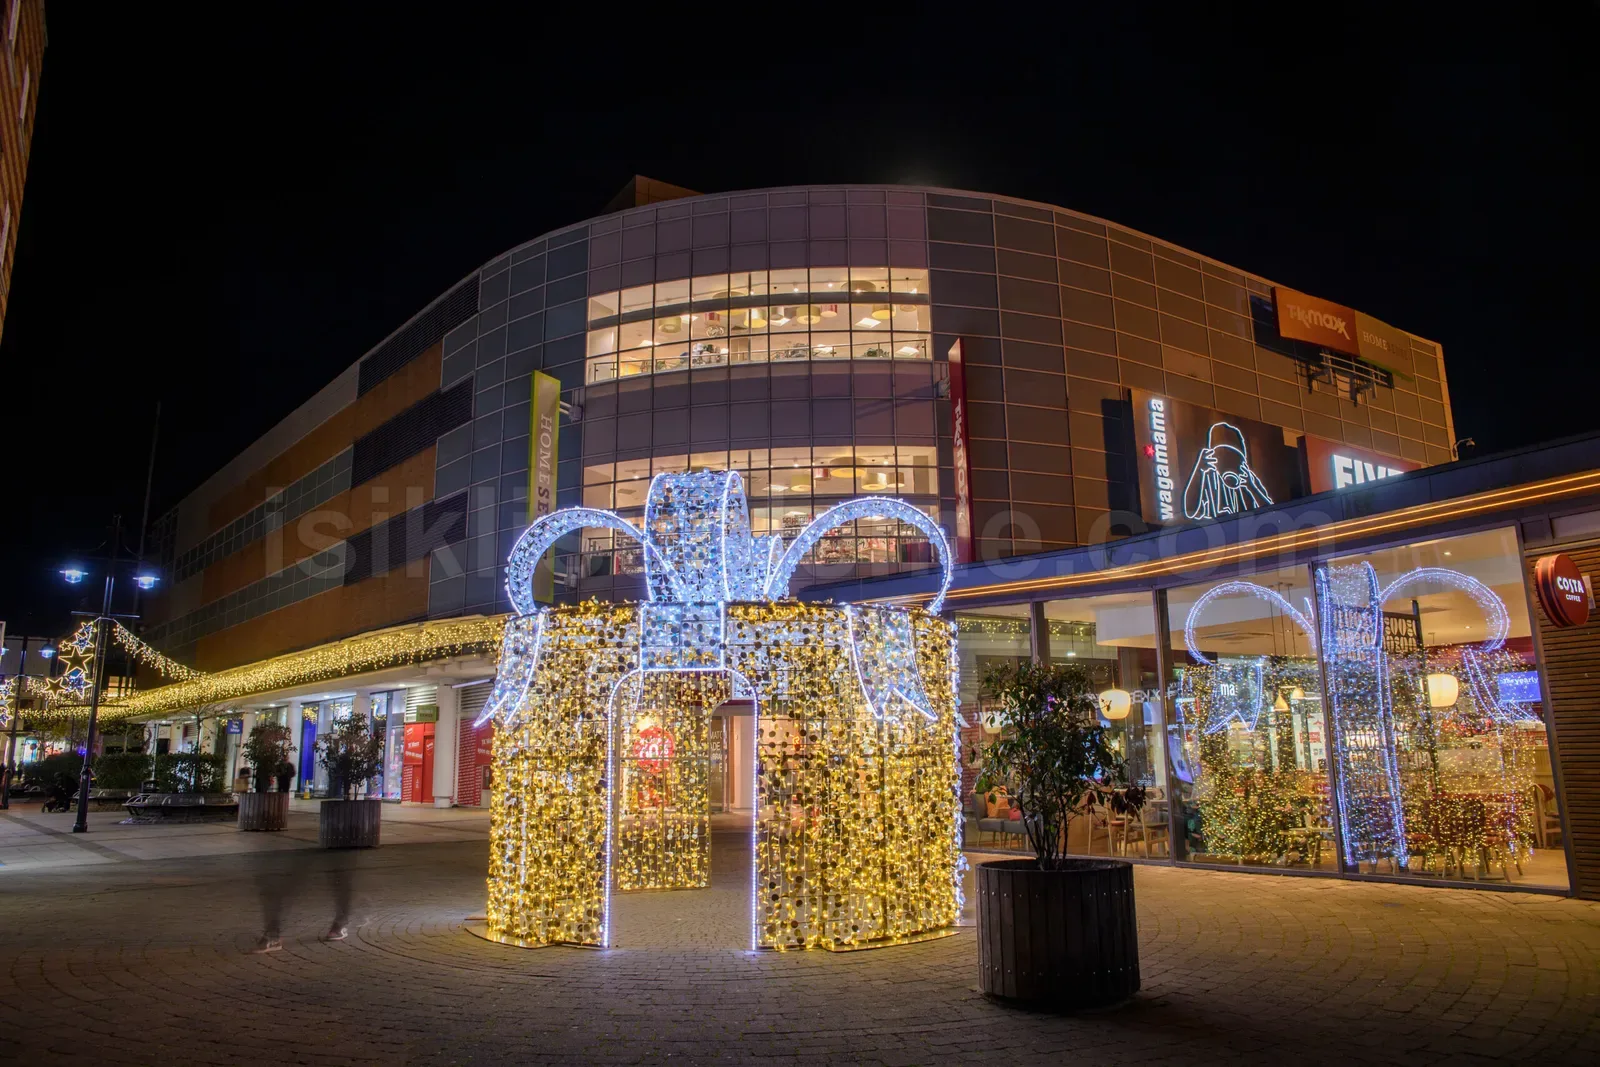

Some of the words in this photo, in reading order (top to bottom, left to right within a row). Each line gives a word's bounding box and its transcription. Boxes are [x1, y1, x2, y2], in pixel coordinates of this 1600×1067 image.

[1149, 398, 1175, 521] wagamama
[1332, 454, 1405, 489] FIV
[1556, 576, 1585, 594] COSTA
